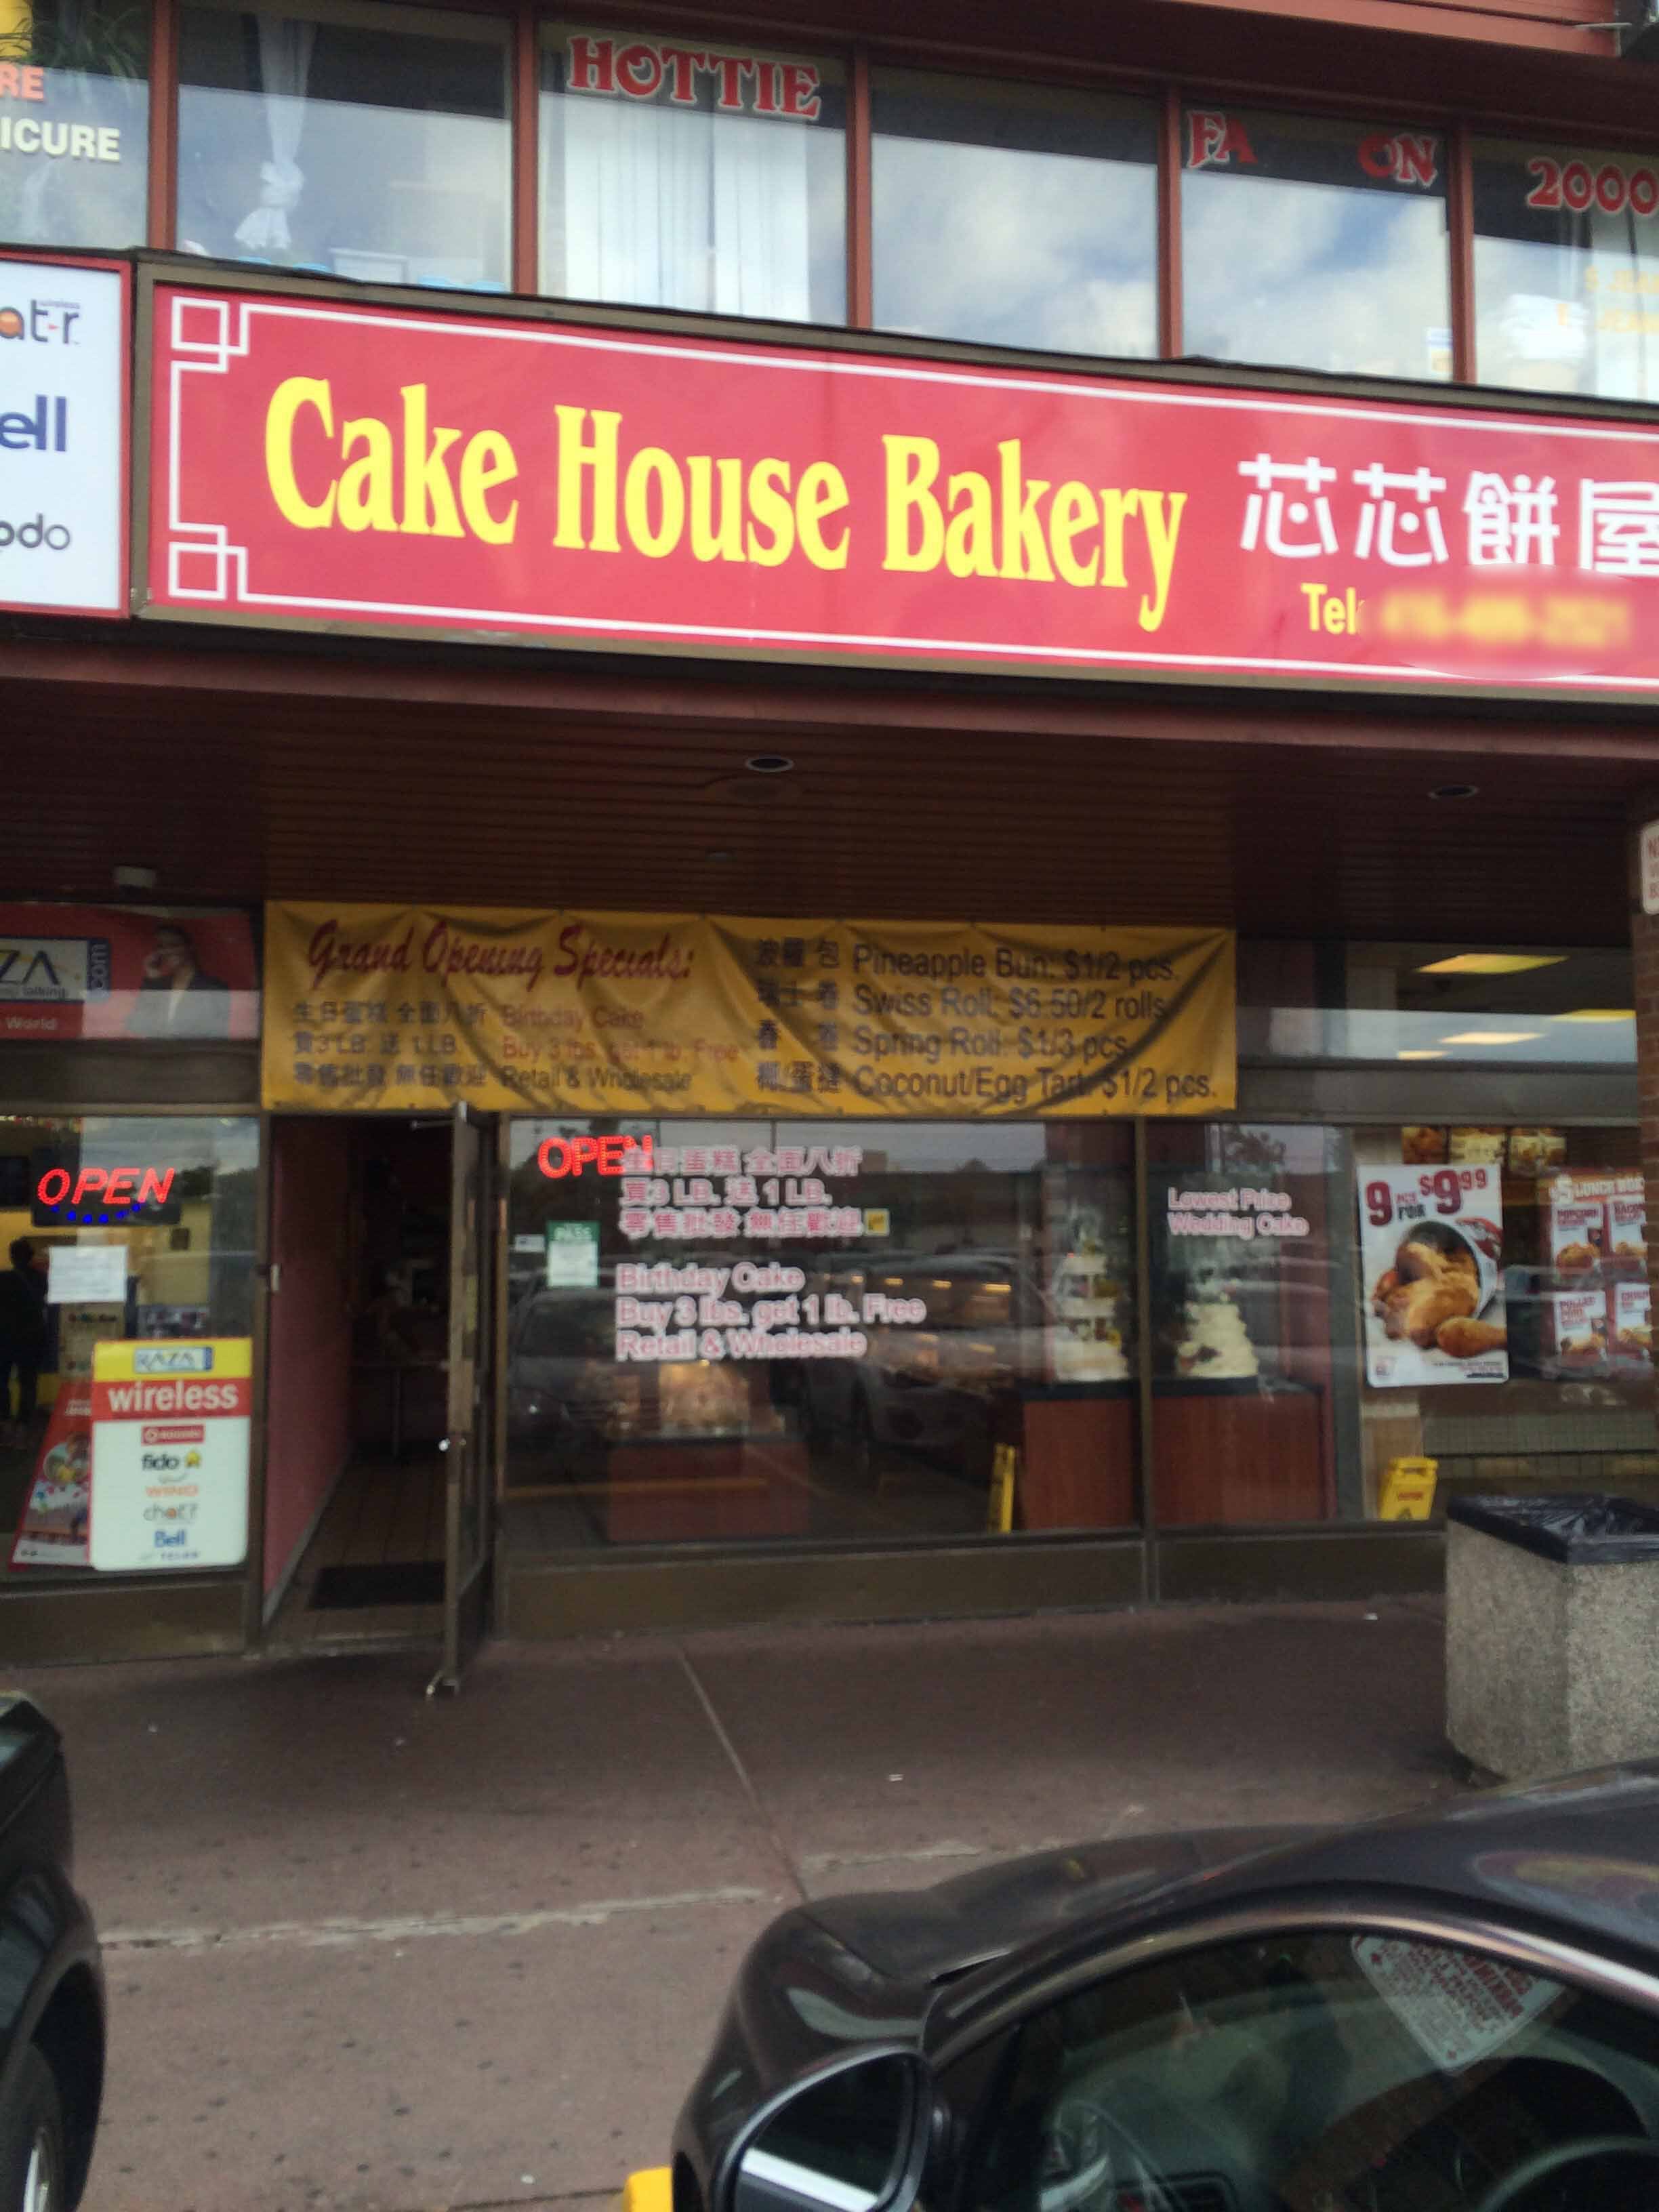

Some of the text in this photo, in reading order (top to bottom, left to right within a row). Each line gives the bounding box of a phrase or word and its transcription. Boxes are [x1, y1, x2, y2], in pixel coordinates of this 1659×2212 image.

[568, 37, 821, 120] HOTTIE
[0, 116, 120, 163] ICURE
[0, 394, 66, 452] ell
[265, 375, 1188, 632] Cake House Bakery
[308, 919, 415, 989] Grand
[422, 920, 544, 992] Opening
[853, 943, 987, 981] Pineapple
[853, 983, 931, 1017] Swiss
[503, 1036, 540, 1063] Buy
[853, 1024, 941, 1065] Spring
[503, 1066, 562, 1090] Retail
[538, 1135, 653, 1179] OPEN
[37, 1167, 176, 1206] OPEN
[1168, 1187, 1292, 1212] Lowest Price
[1366, 1181, 1392, 1226] 9
[1166, 1212, 1311, 1240] Wedding Cake
[616, 1263, 731, 1297] Birthday
[731, 1261, 806, 1293] Cake
[616, 1296, 674, 1331] Buy
[674, 1295, 697, 1326] 3
[751, 1294, 800, 1334] get
[801, 1293, 820, 1325] 1
[862, 1292, 927, 1324] Free
[615, 1326, 868, 1361] Retail & Wholesale
[108, 1380, 239, 1412] wireless
